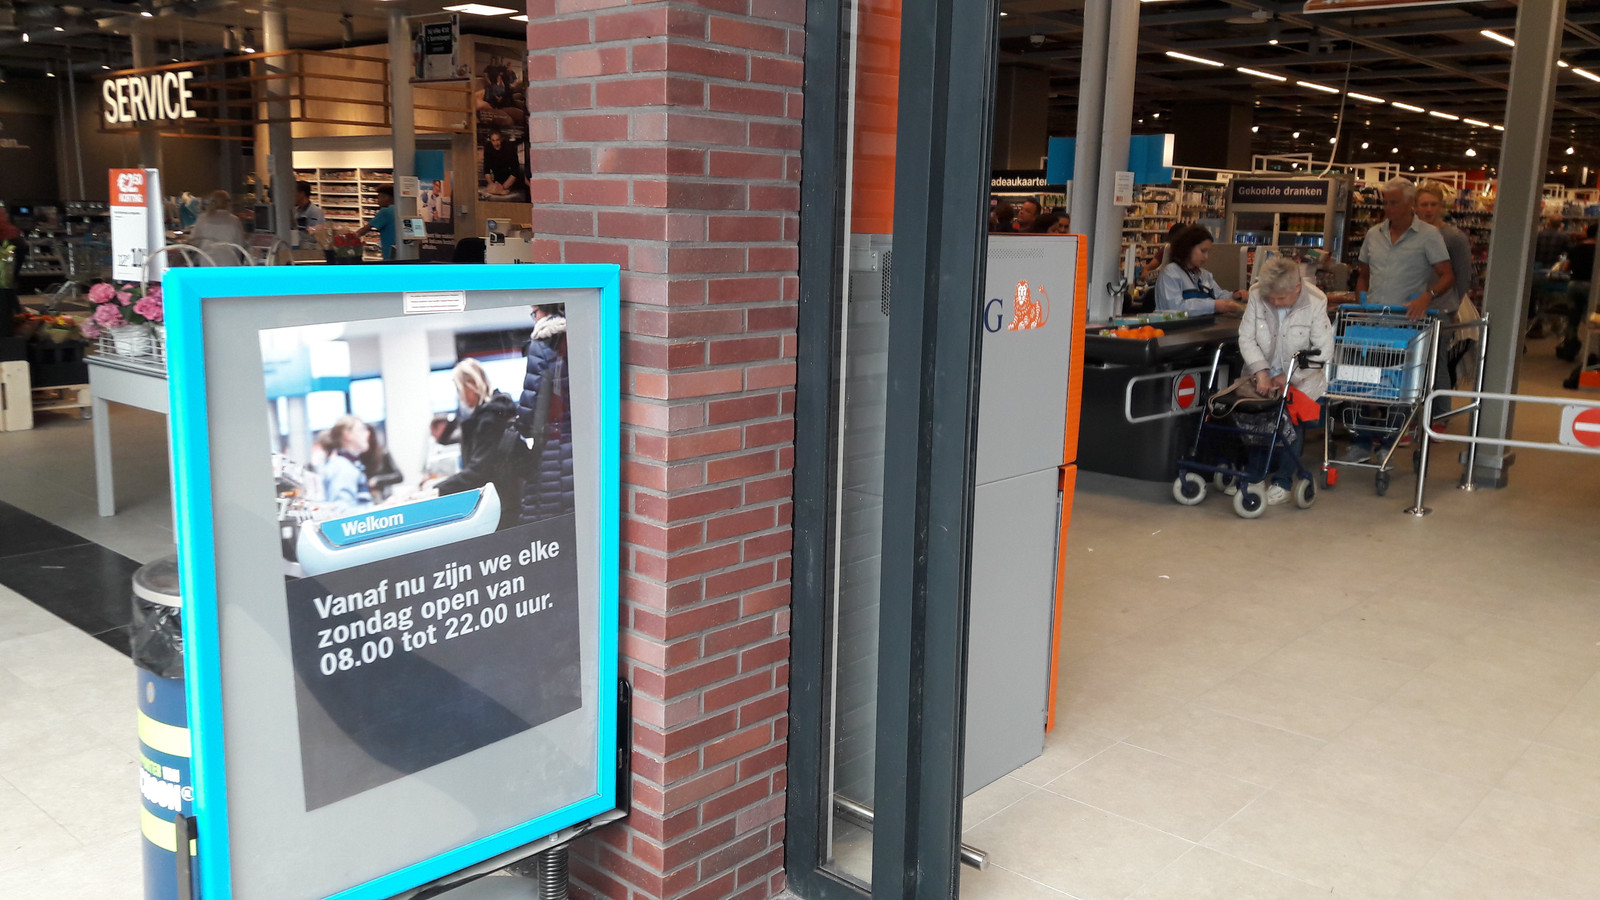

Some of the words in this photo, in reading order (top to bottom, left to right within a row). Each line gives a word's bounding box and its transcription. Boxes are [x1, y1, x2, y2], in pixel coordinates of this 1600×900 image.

[102, 70, 197, 124] SERVICE
[1238, 186, 1281, 196] Gekoelde
[1283, 186, 1323, 196] dranken
[341, 513, 404, 537] Welkom
[313, 578, 388, 620] Vanaf
[394, 576, 426, 600] nu
[433, 562, 472, 590] zijn
[479, 556, 512, 577] we
[518, 540, 560, 566] elke
[317, 605, 414, 649] zondag
[420, 589, 479, 621] open
[486, 575, 526, 600] van
[319, 636, 394, 676] 08.00
[402, 624, 438, 652] tot
[445, 603, 508, 640] 22.00
[515, 592, 554, 618] uur.
